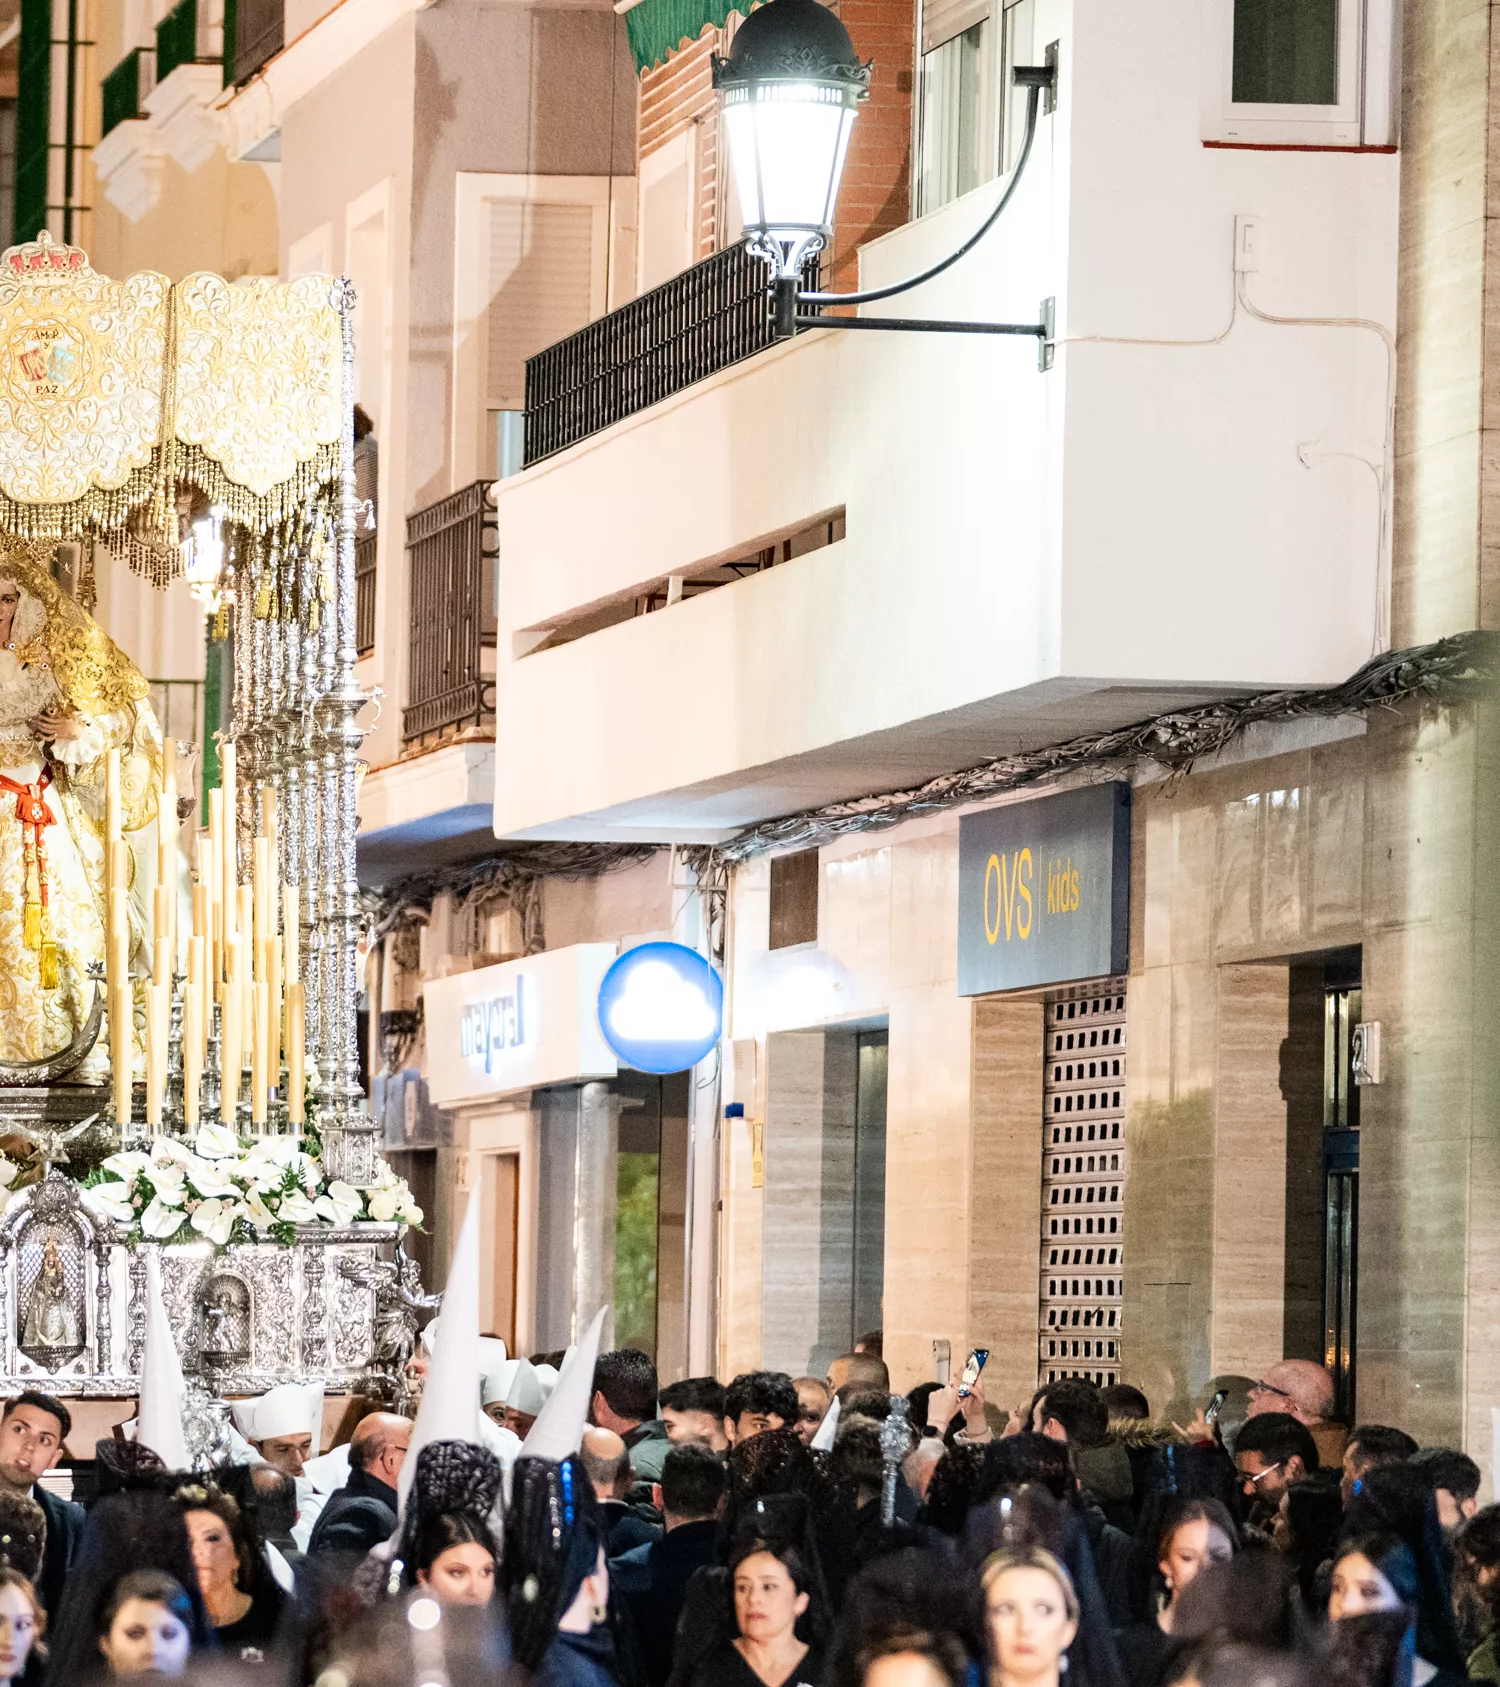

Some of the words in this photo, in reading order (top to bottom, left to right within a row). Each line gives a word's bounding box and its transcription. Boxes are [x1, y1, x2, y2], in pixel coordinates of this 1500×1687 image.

[35, 385, 59, 394] PAZ
[984, 847, 1033, 946] OVS
[1046, 856, 1080, 915] kids
